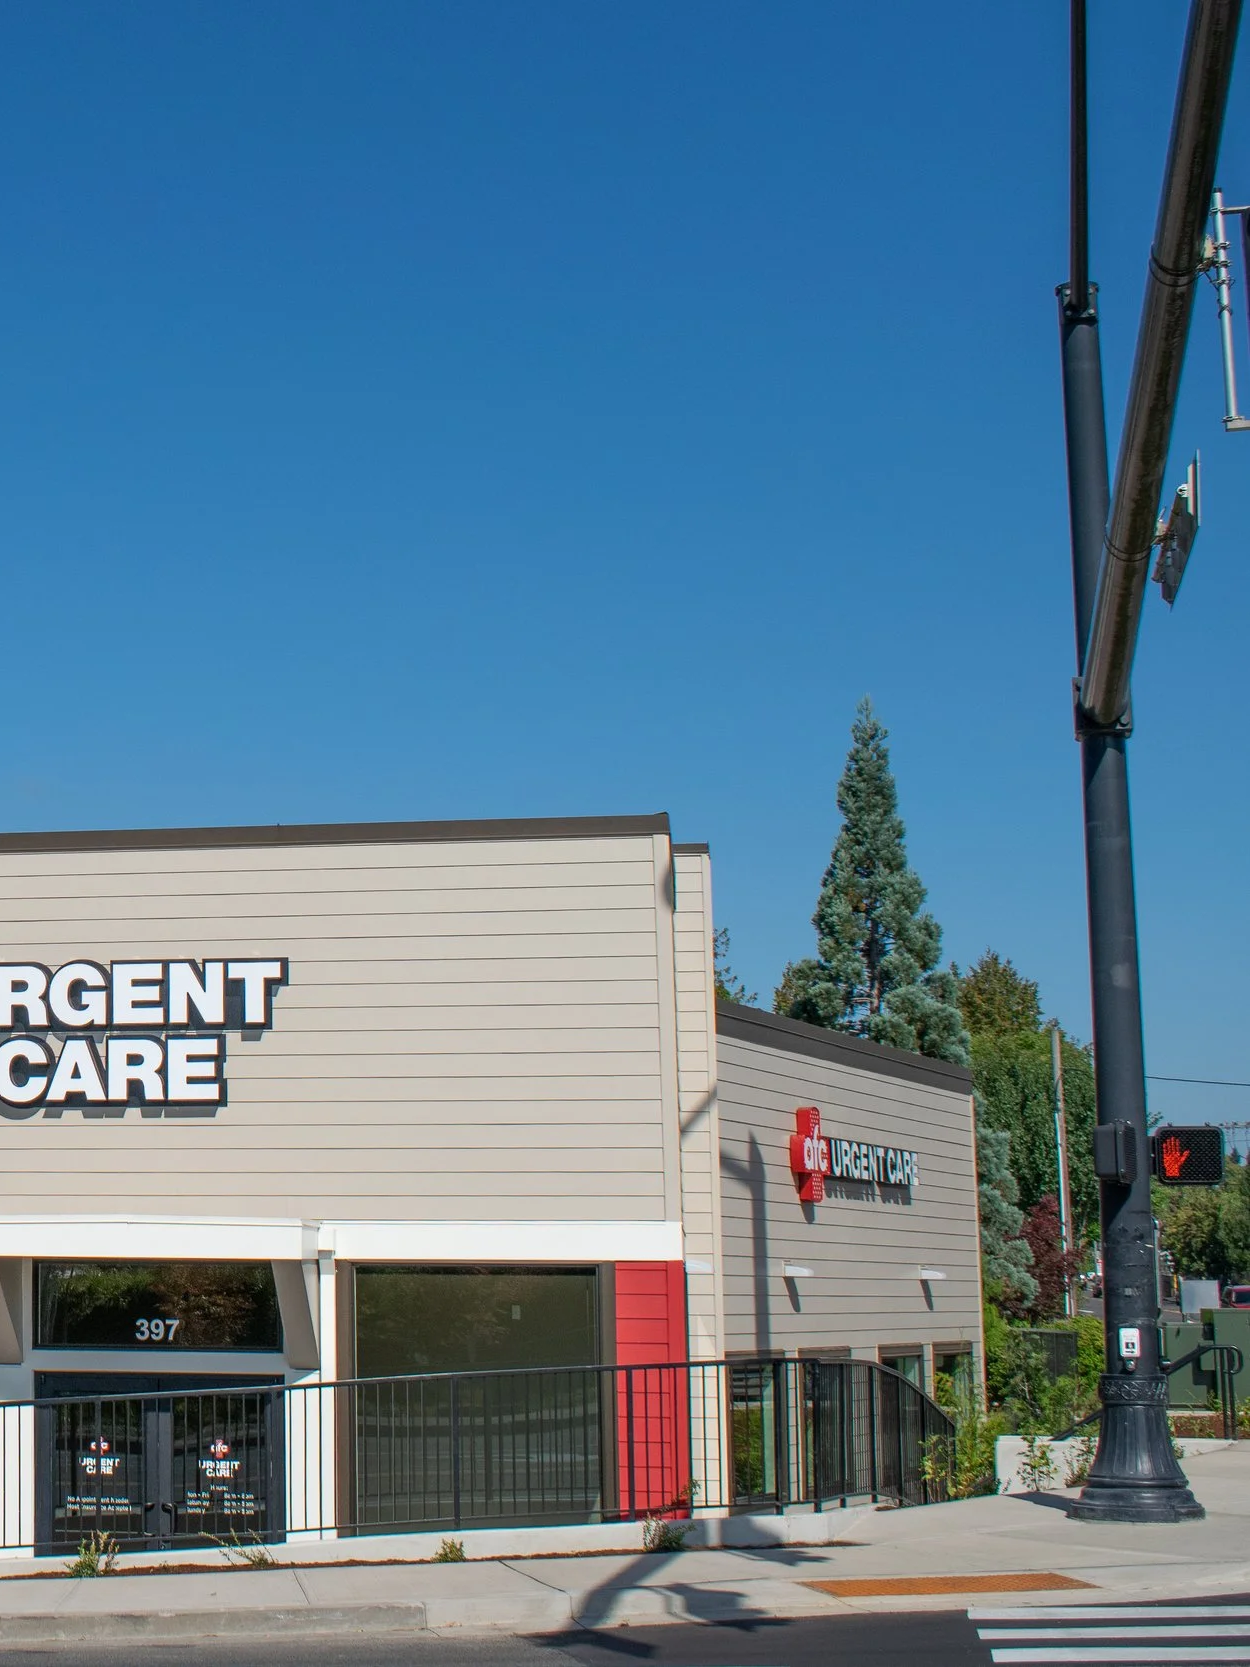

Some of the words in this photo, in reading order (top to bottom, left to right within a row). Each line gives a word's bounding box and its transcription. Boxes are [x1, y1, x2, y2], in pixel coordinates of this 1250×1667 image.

[803, 1124, 829, 1172] afc
[830, 1139, 885, 1183] URGENT
[885, 1148, 920, 1186] CARE
[134, 1318, 180, 1341] 397
[90, 1439, 109, 1449] ac
